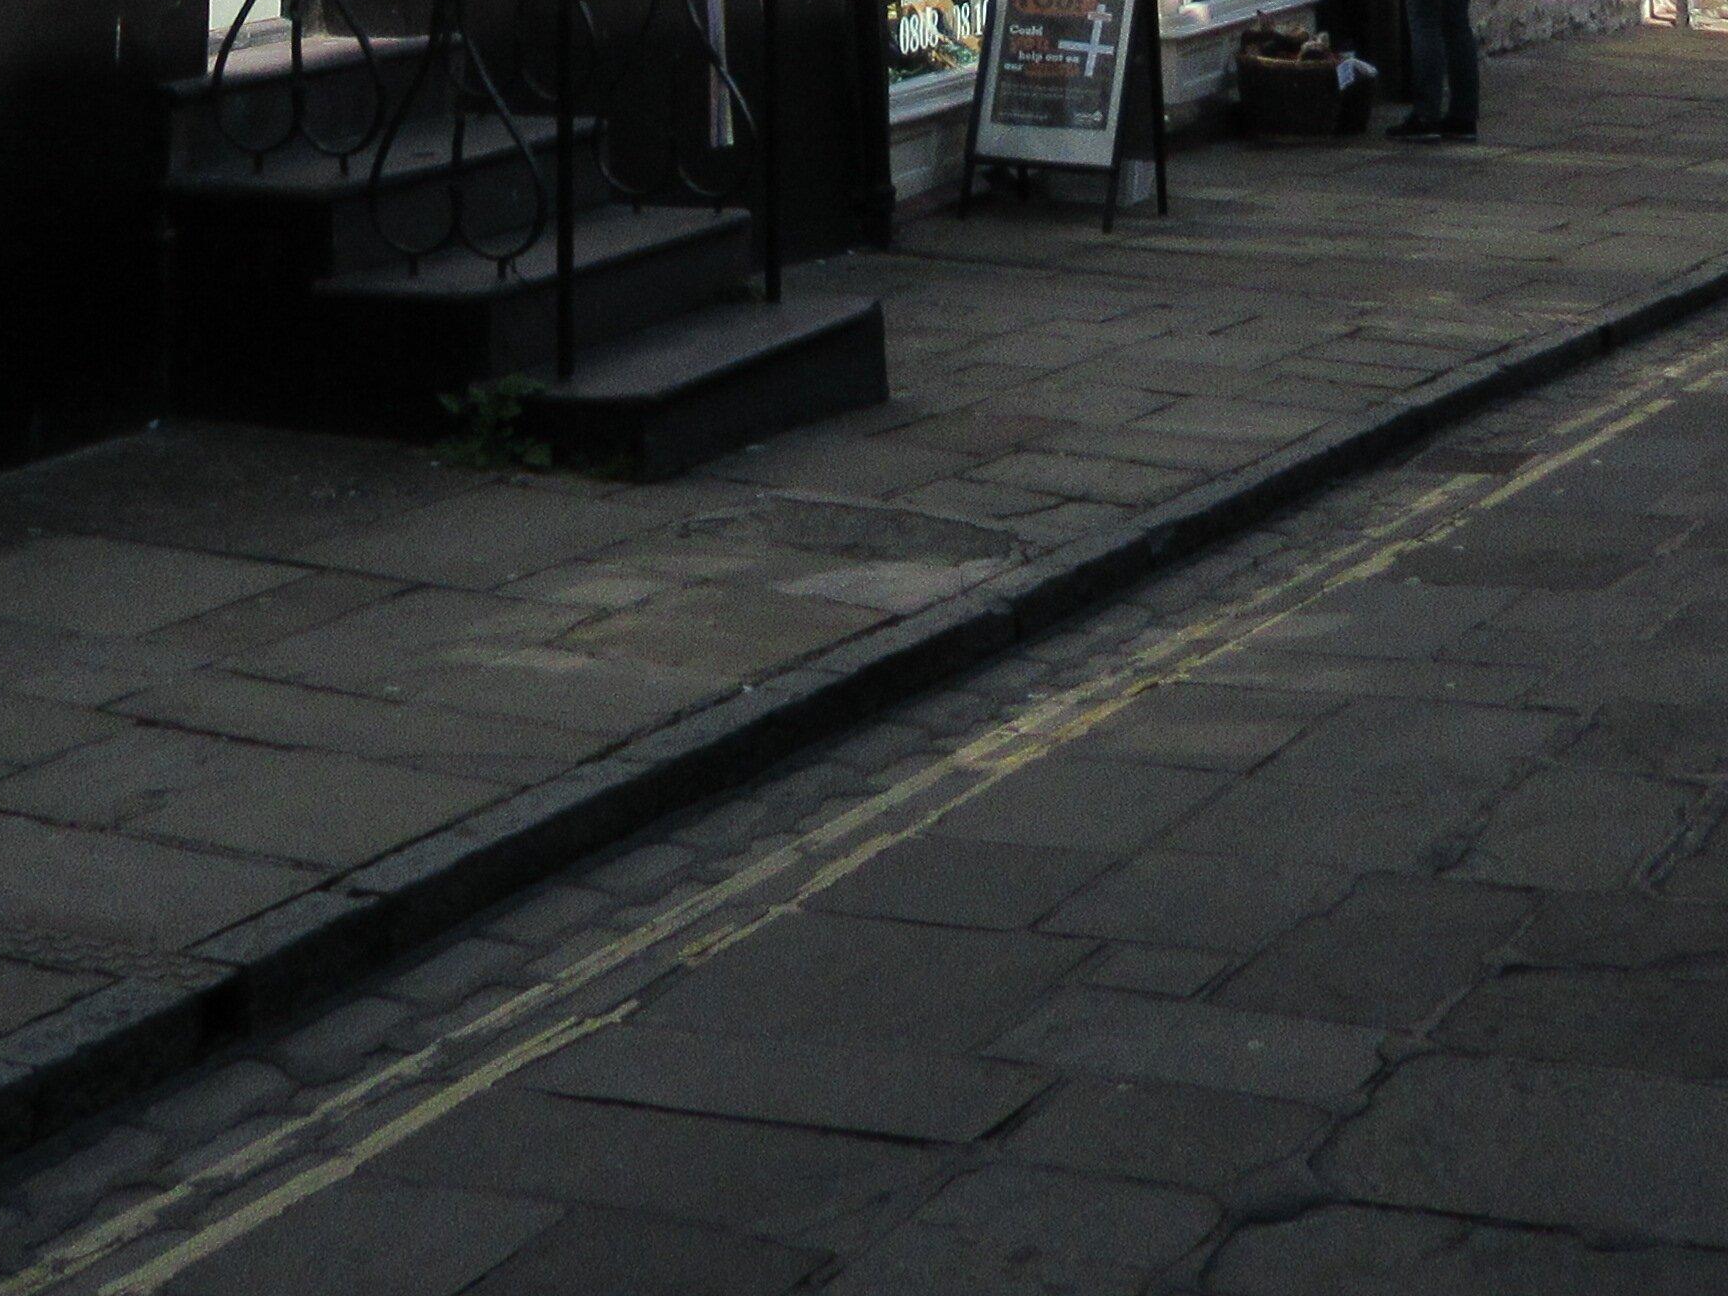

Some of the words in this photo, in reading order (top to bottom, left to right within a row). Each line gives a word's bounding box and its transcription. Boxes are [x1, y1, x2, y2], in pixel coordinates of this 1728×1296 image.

[899, 7, 939, 55] 0808
[1009, 24, 1044, 37] Could
[1018, 50, 1043, 64] help
[1044, 52, 1064, 63] out
